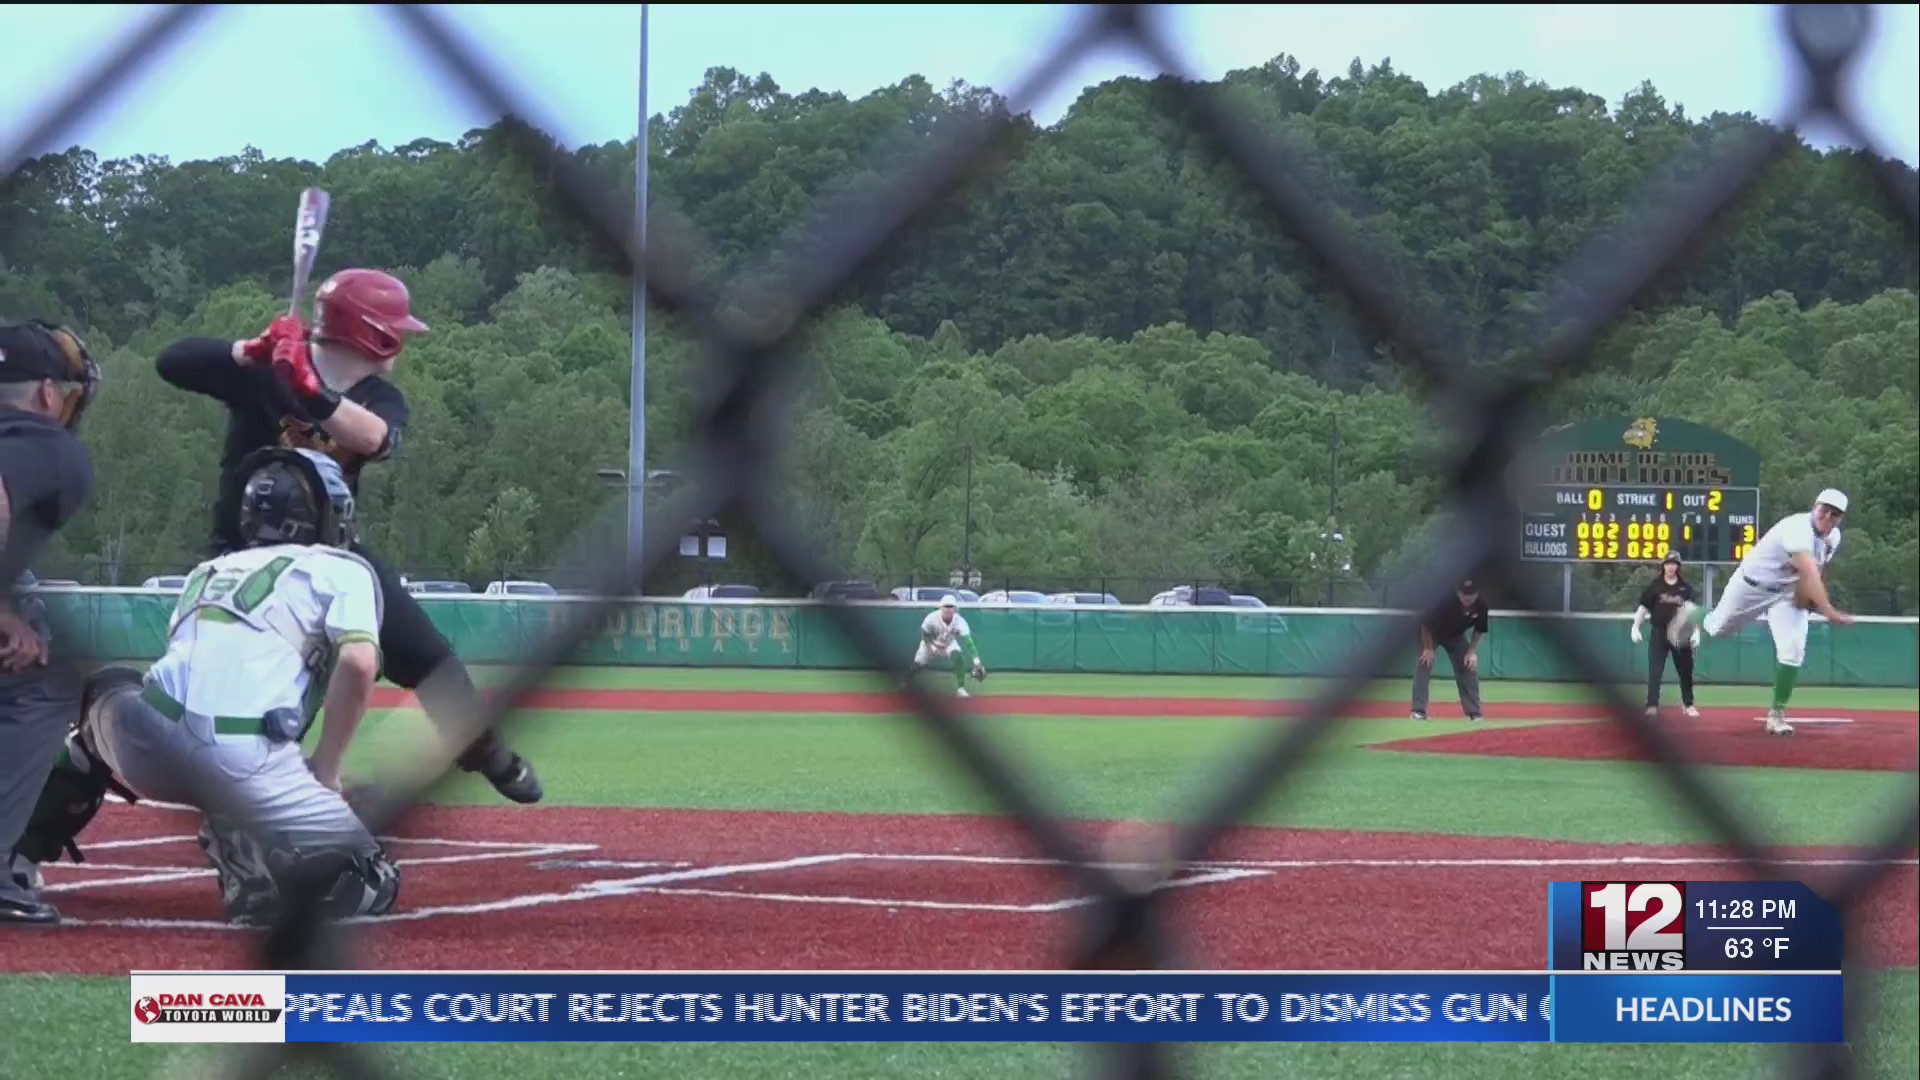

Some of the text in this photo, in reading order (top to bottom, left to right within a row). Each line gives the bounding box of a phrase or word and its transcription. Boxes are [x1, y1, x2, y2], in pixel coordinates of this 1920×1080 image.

[1556, 489, 1722, 511] BALL 0 STRIKE 1 OUT 2
[1581, 513, 1587, 521] 1
[1595, 513, 1601, 521] 2
[1609, 513, 1616, 522] 3
[1630, 513, 1637, 522] 4
[1728, 515, 1755, 524] RUNS
[1525, 523, 1566, 537] GUEST
[1683, 525, 1691, 540] 1
[1743, 524, 1755, 542] 3
[1525, 541, 1567, 556] BULLDOGS
